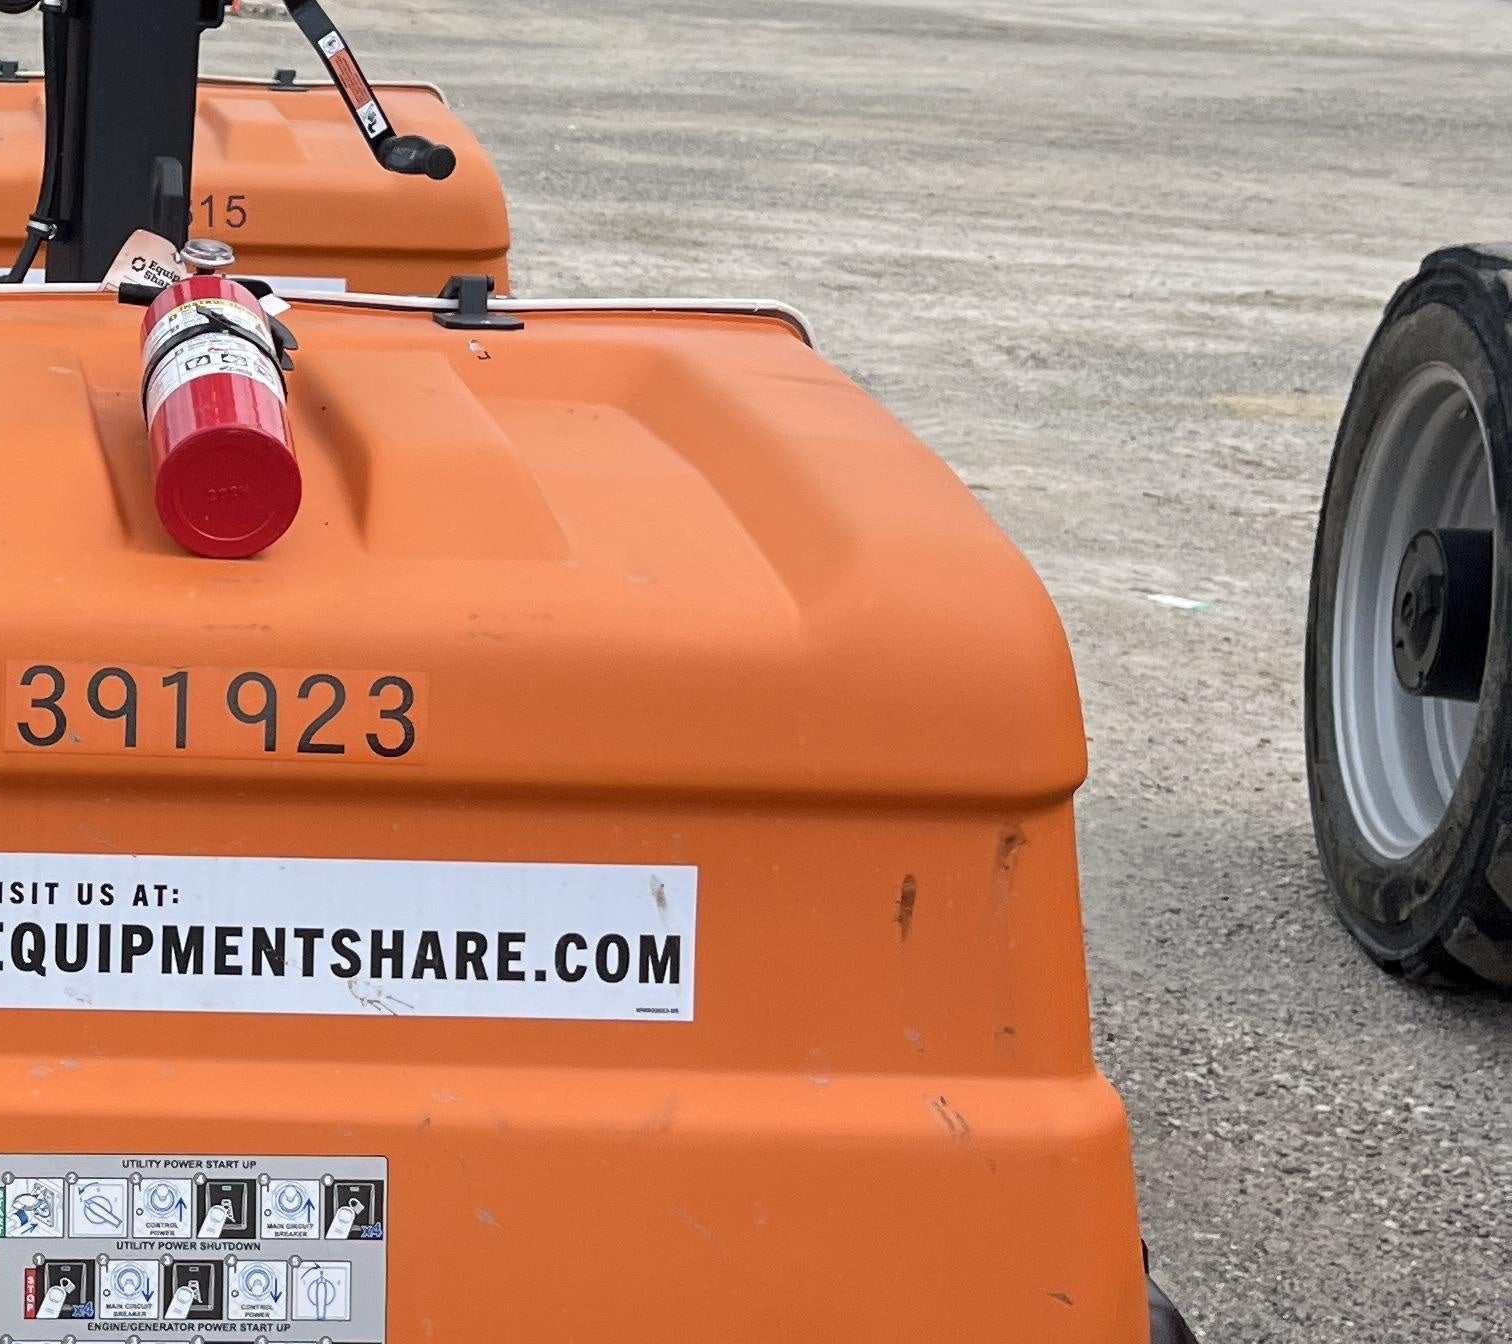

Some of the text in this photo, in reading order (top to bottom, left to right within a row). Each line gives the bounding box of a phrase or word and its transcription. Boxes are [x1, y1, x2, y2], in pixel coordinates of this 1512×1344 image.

[189, 194, 247, 228] 15
[143, 270, 172, 288] Shar
[148, 260, 181, 283] Equip
[16, 664, 416, 758] 391923
[77, 882, 115, 906] US
[132, 884, 180, 907] AT:
[122, 1159, 257, 1169] UTILITY POWER START UP
[116, 1241, 261, 1252] UTILITY POWER SHUTDOWN
[88, 1322, 291, 1333] ENGINE/GENERATOR POWER START UP
